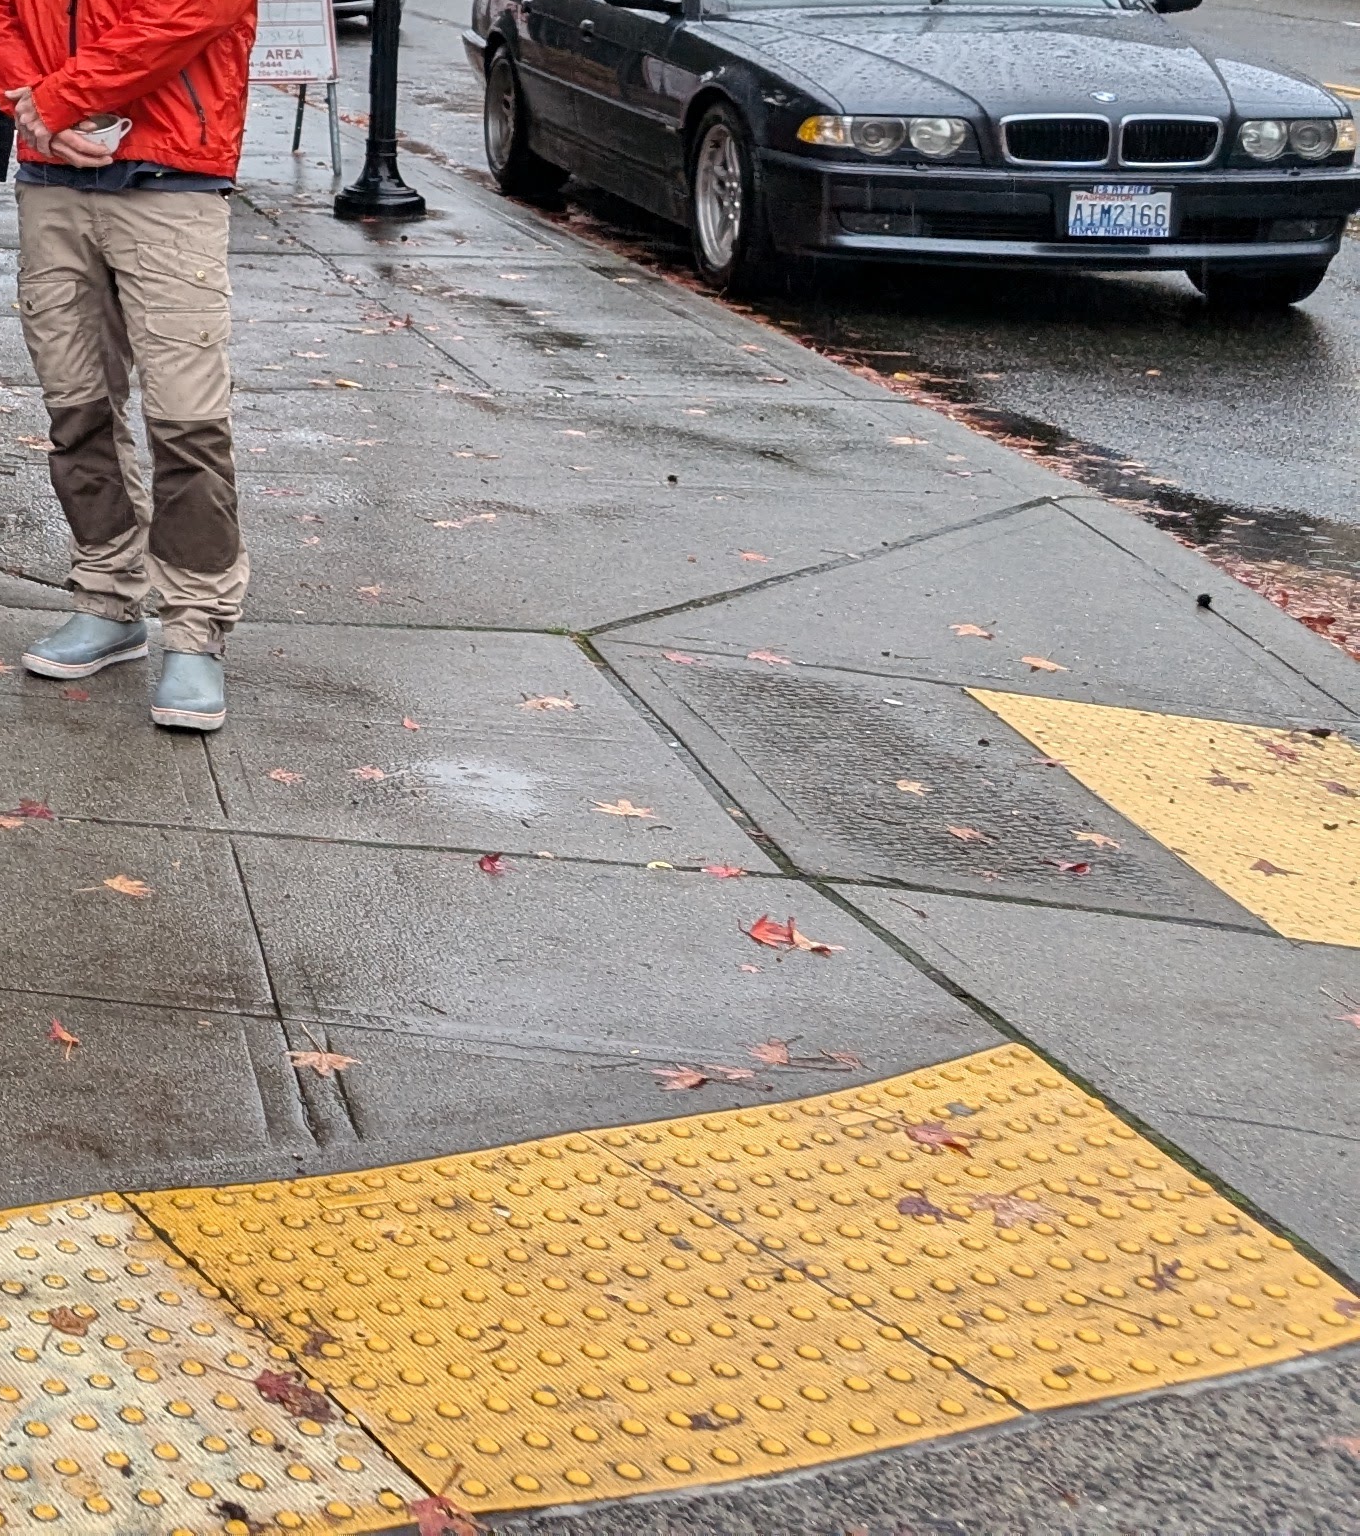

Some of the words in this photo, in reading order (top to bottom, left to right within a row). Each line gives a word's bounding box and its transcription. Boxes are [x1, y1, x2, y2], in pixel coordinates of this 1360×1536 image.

[265, 49, 304, 60] AREA
[1075, 194, 1133, 202] WASHINGTON
[1072, 203, 1167, 227] AIM2166
